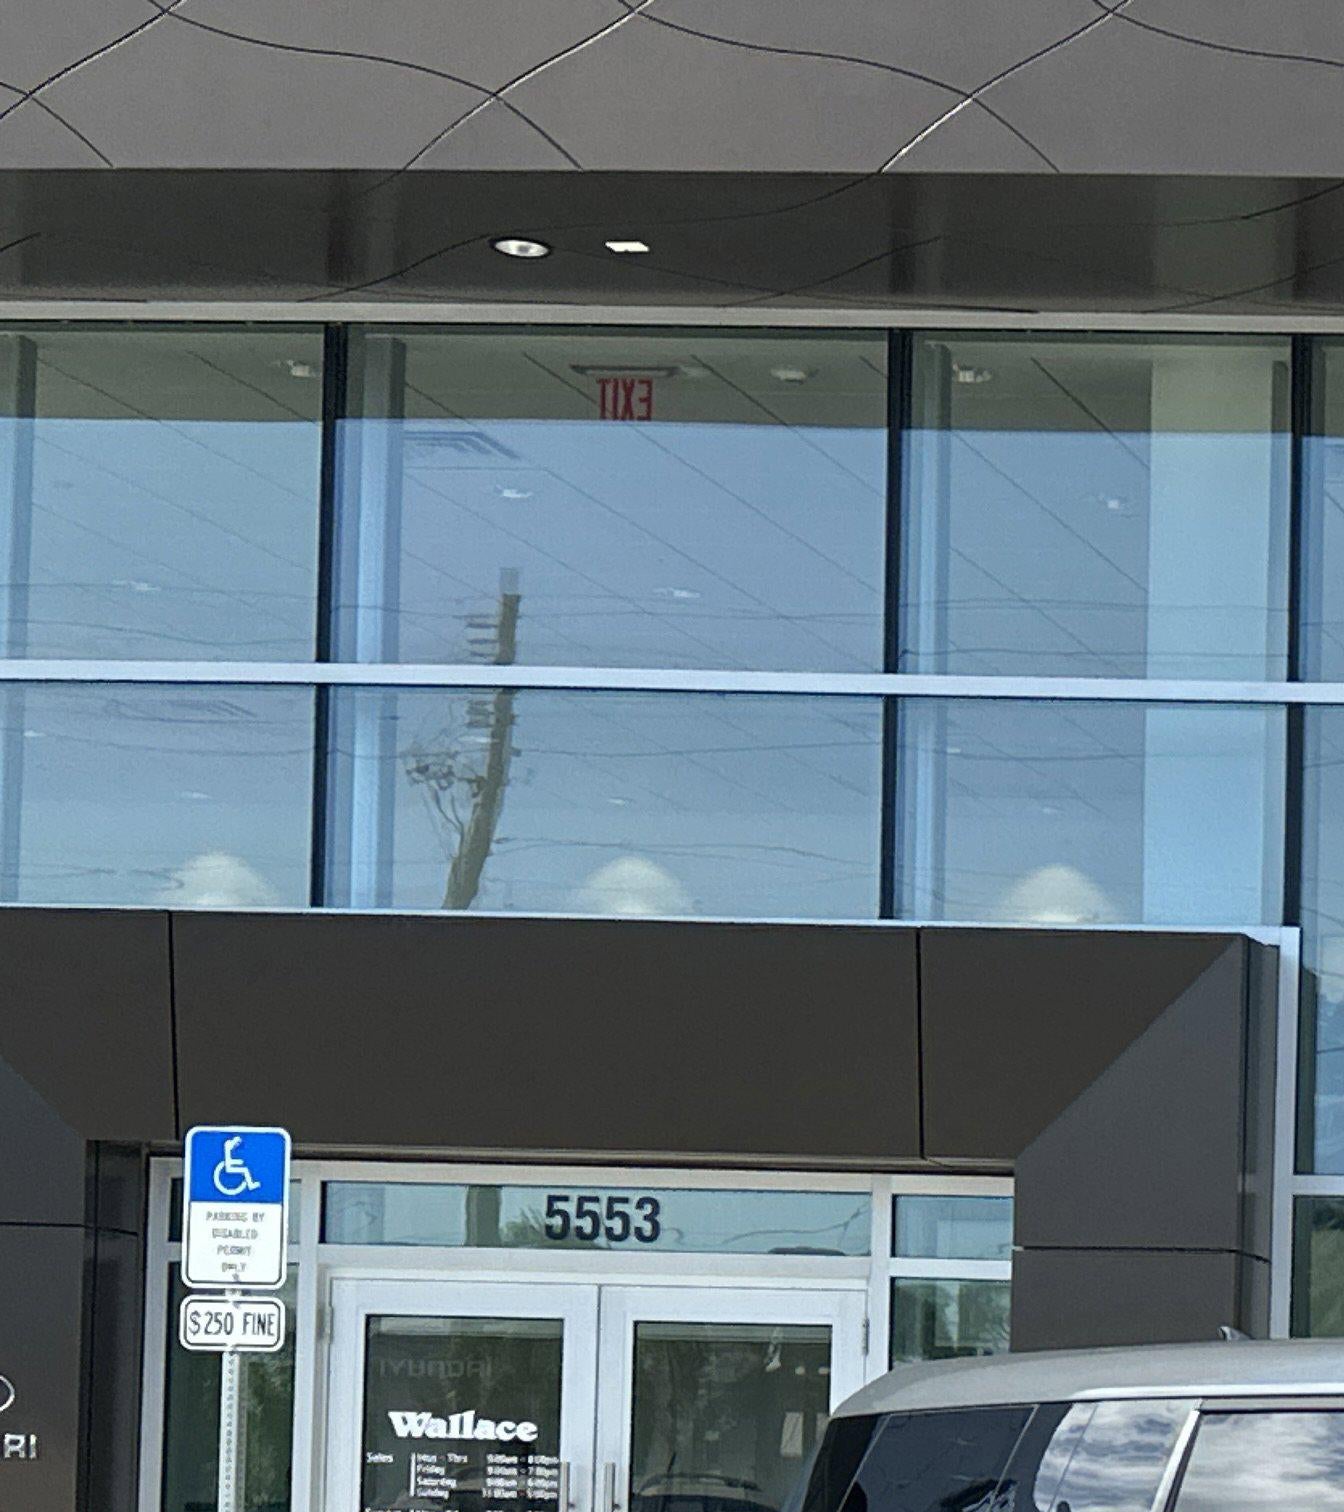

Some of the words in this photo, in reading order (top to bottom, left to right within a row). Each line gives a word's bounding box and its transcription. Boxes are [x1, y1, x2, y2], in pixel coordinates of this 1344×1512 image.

[545, 1194, 661, 1243] 5553
[189, 1309, 234, 1336] $250
[242, 1312, 275, 1337] FINE
[388, 1410, 539, 1443] Wallace
